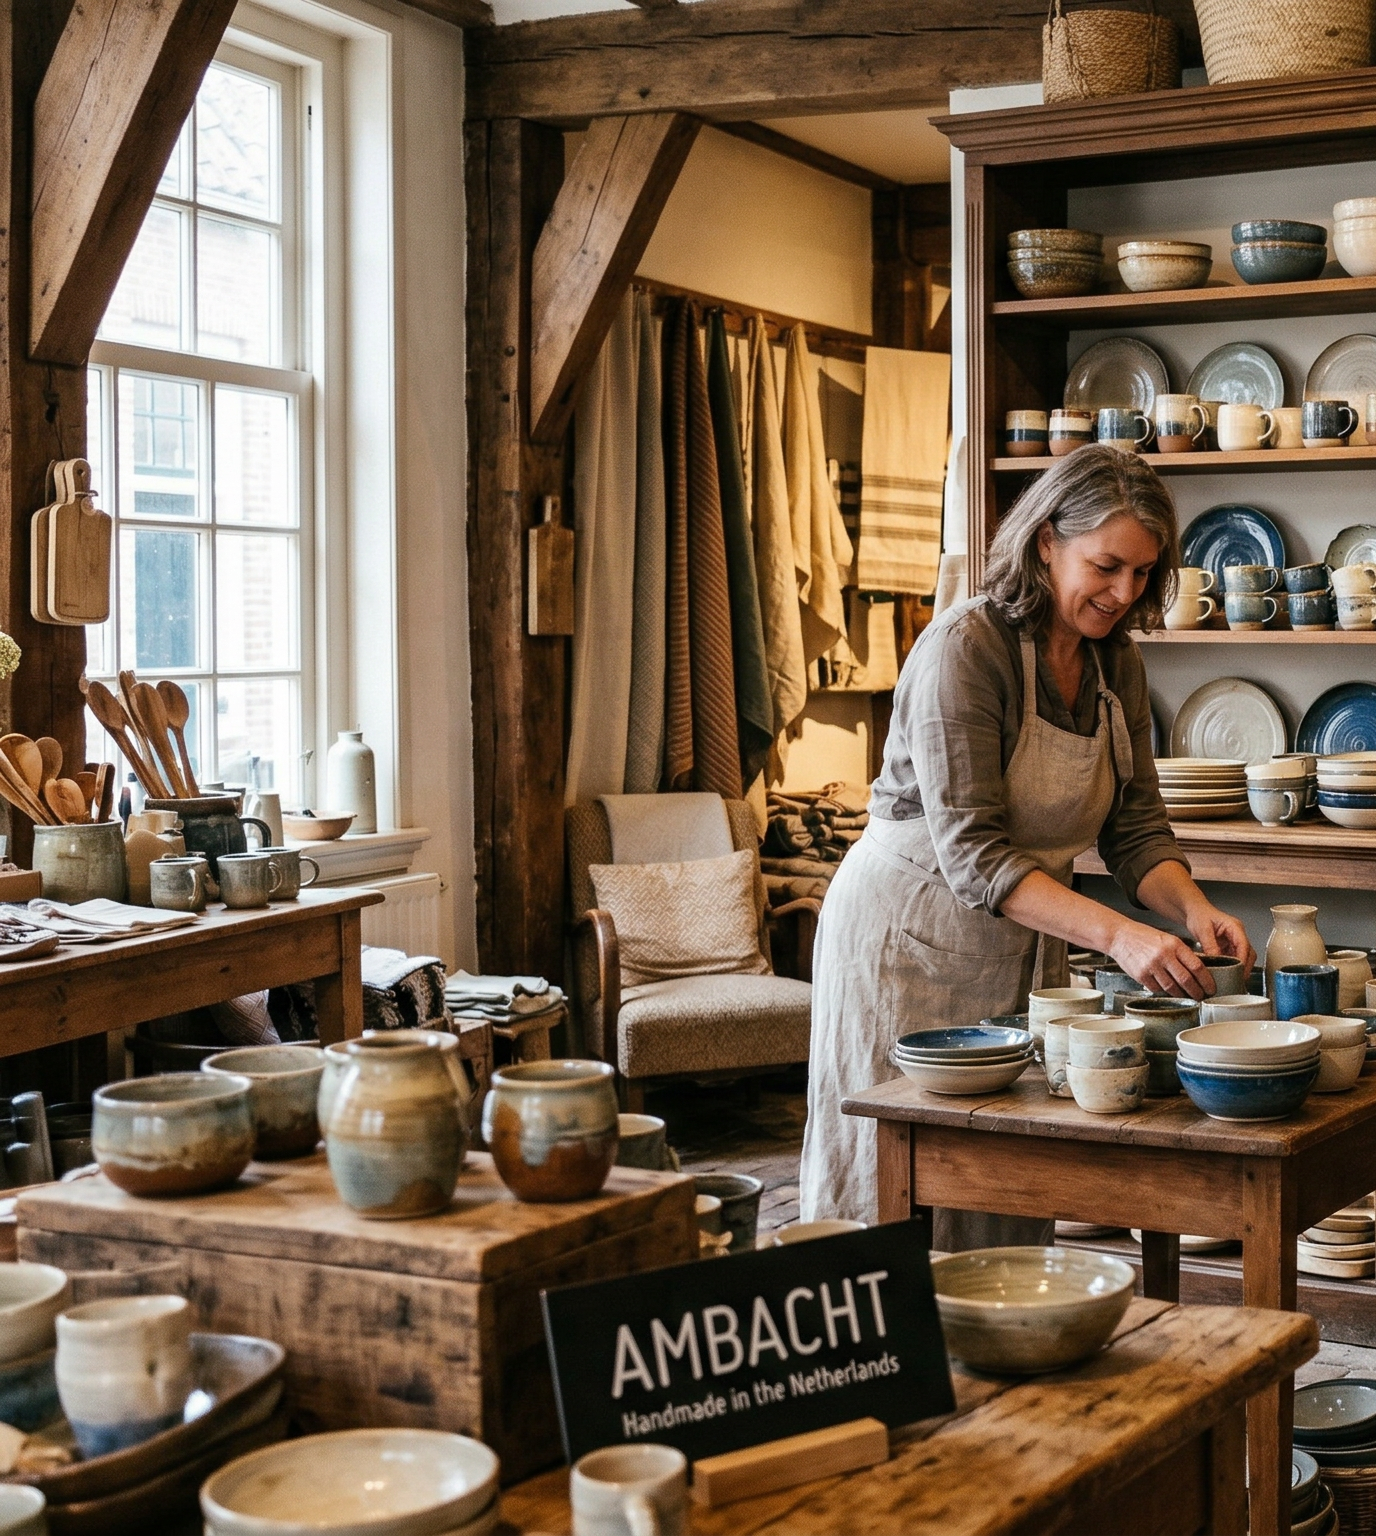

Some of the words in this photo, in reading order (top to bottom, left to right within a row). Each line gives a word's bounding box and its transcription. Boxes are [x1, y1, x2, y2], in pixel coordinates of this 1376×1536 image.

[611, 1270, 889, 1399] AMBACHT
[622, 1394, 727, 1438] Handmade
[731, 1387, 751, 1411] in
[754, 1378, 786, 1402] the
[791, 1351, 901, 1398] Netherlands
